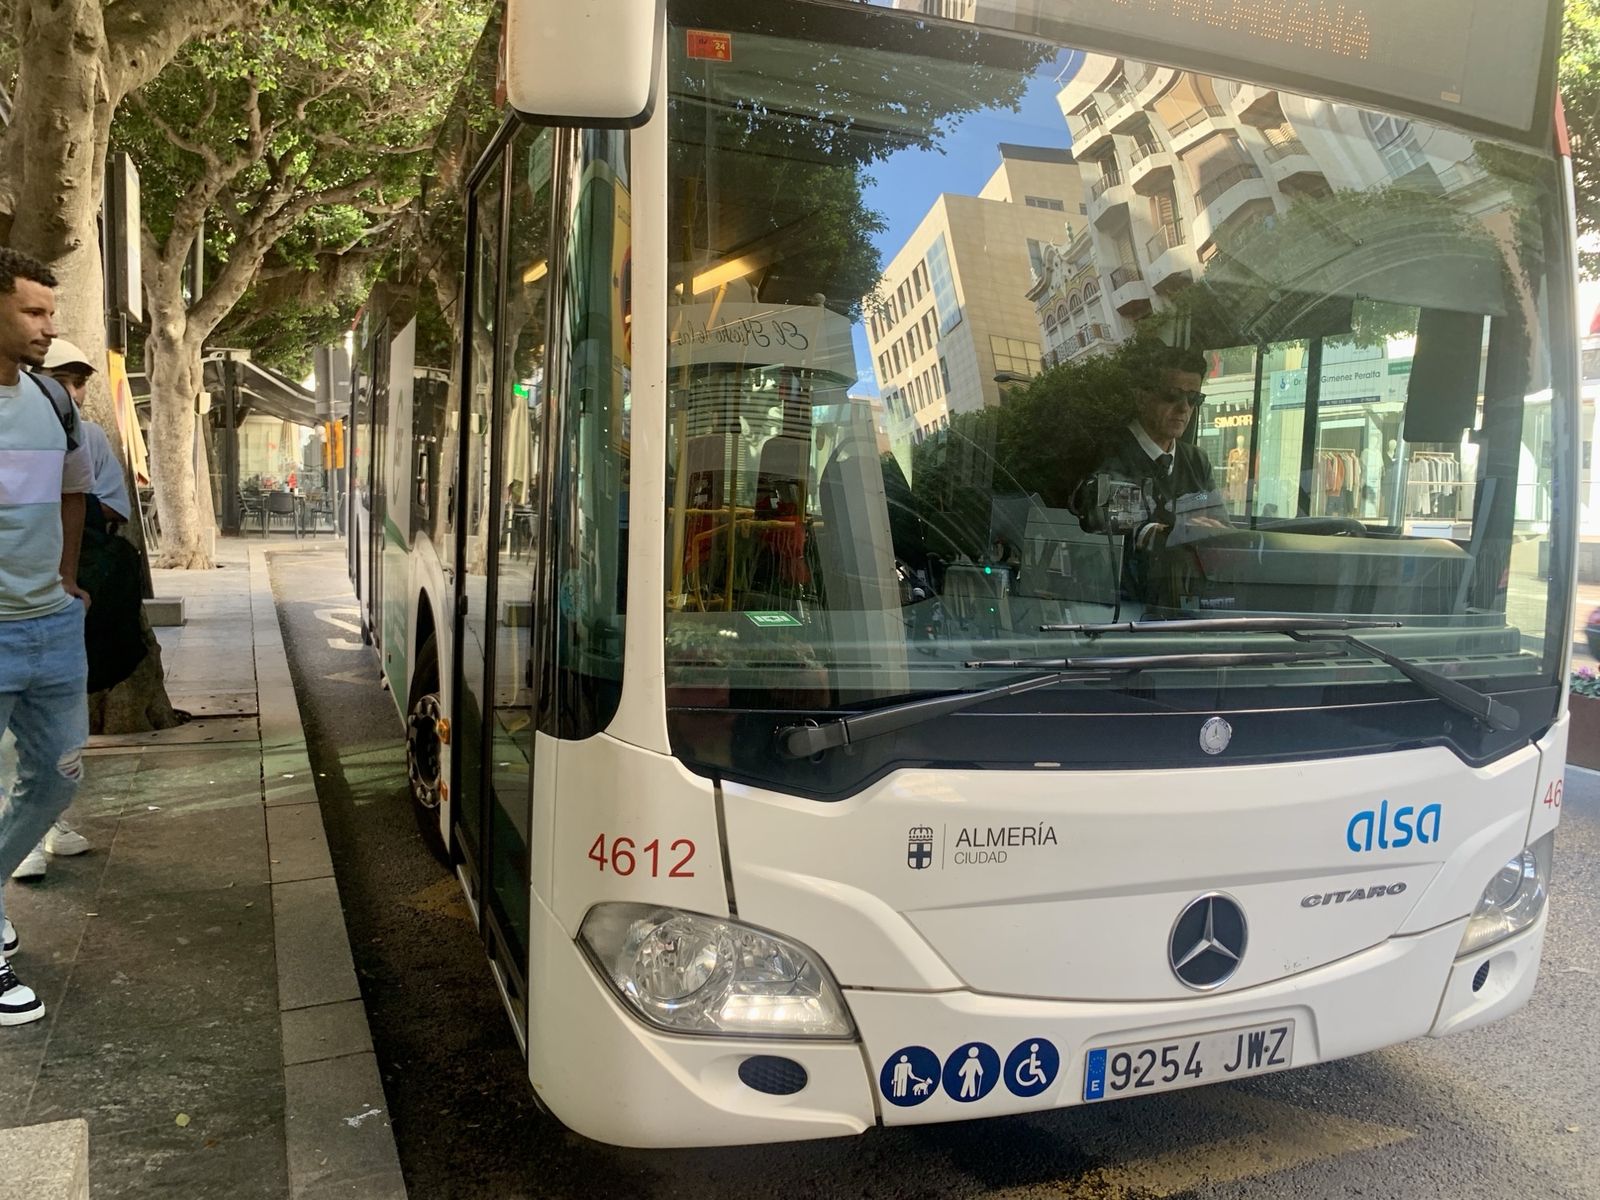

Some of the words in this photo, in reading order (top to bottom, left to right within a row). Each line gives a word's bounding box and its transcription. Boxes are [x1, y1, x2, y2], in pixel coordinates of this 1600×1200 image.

[1354, 370, 1381, 380] Peralta
[955, 821, 1058, 848] ALMERÍA
[1346, 799, 1442, 853] alsa
[588, 833, 696, 879] 4612
[953, 850, 1008, 865] CIUDAD
[1300, 882, 1408, 909] CITARO
[1110, 1041, 1203, 1091] 9254
[1223, 1027, 1288, 1073] JWZ
[1090, 1079, 1100, 1092] E
